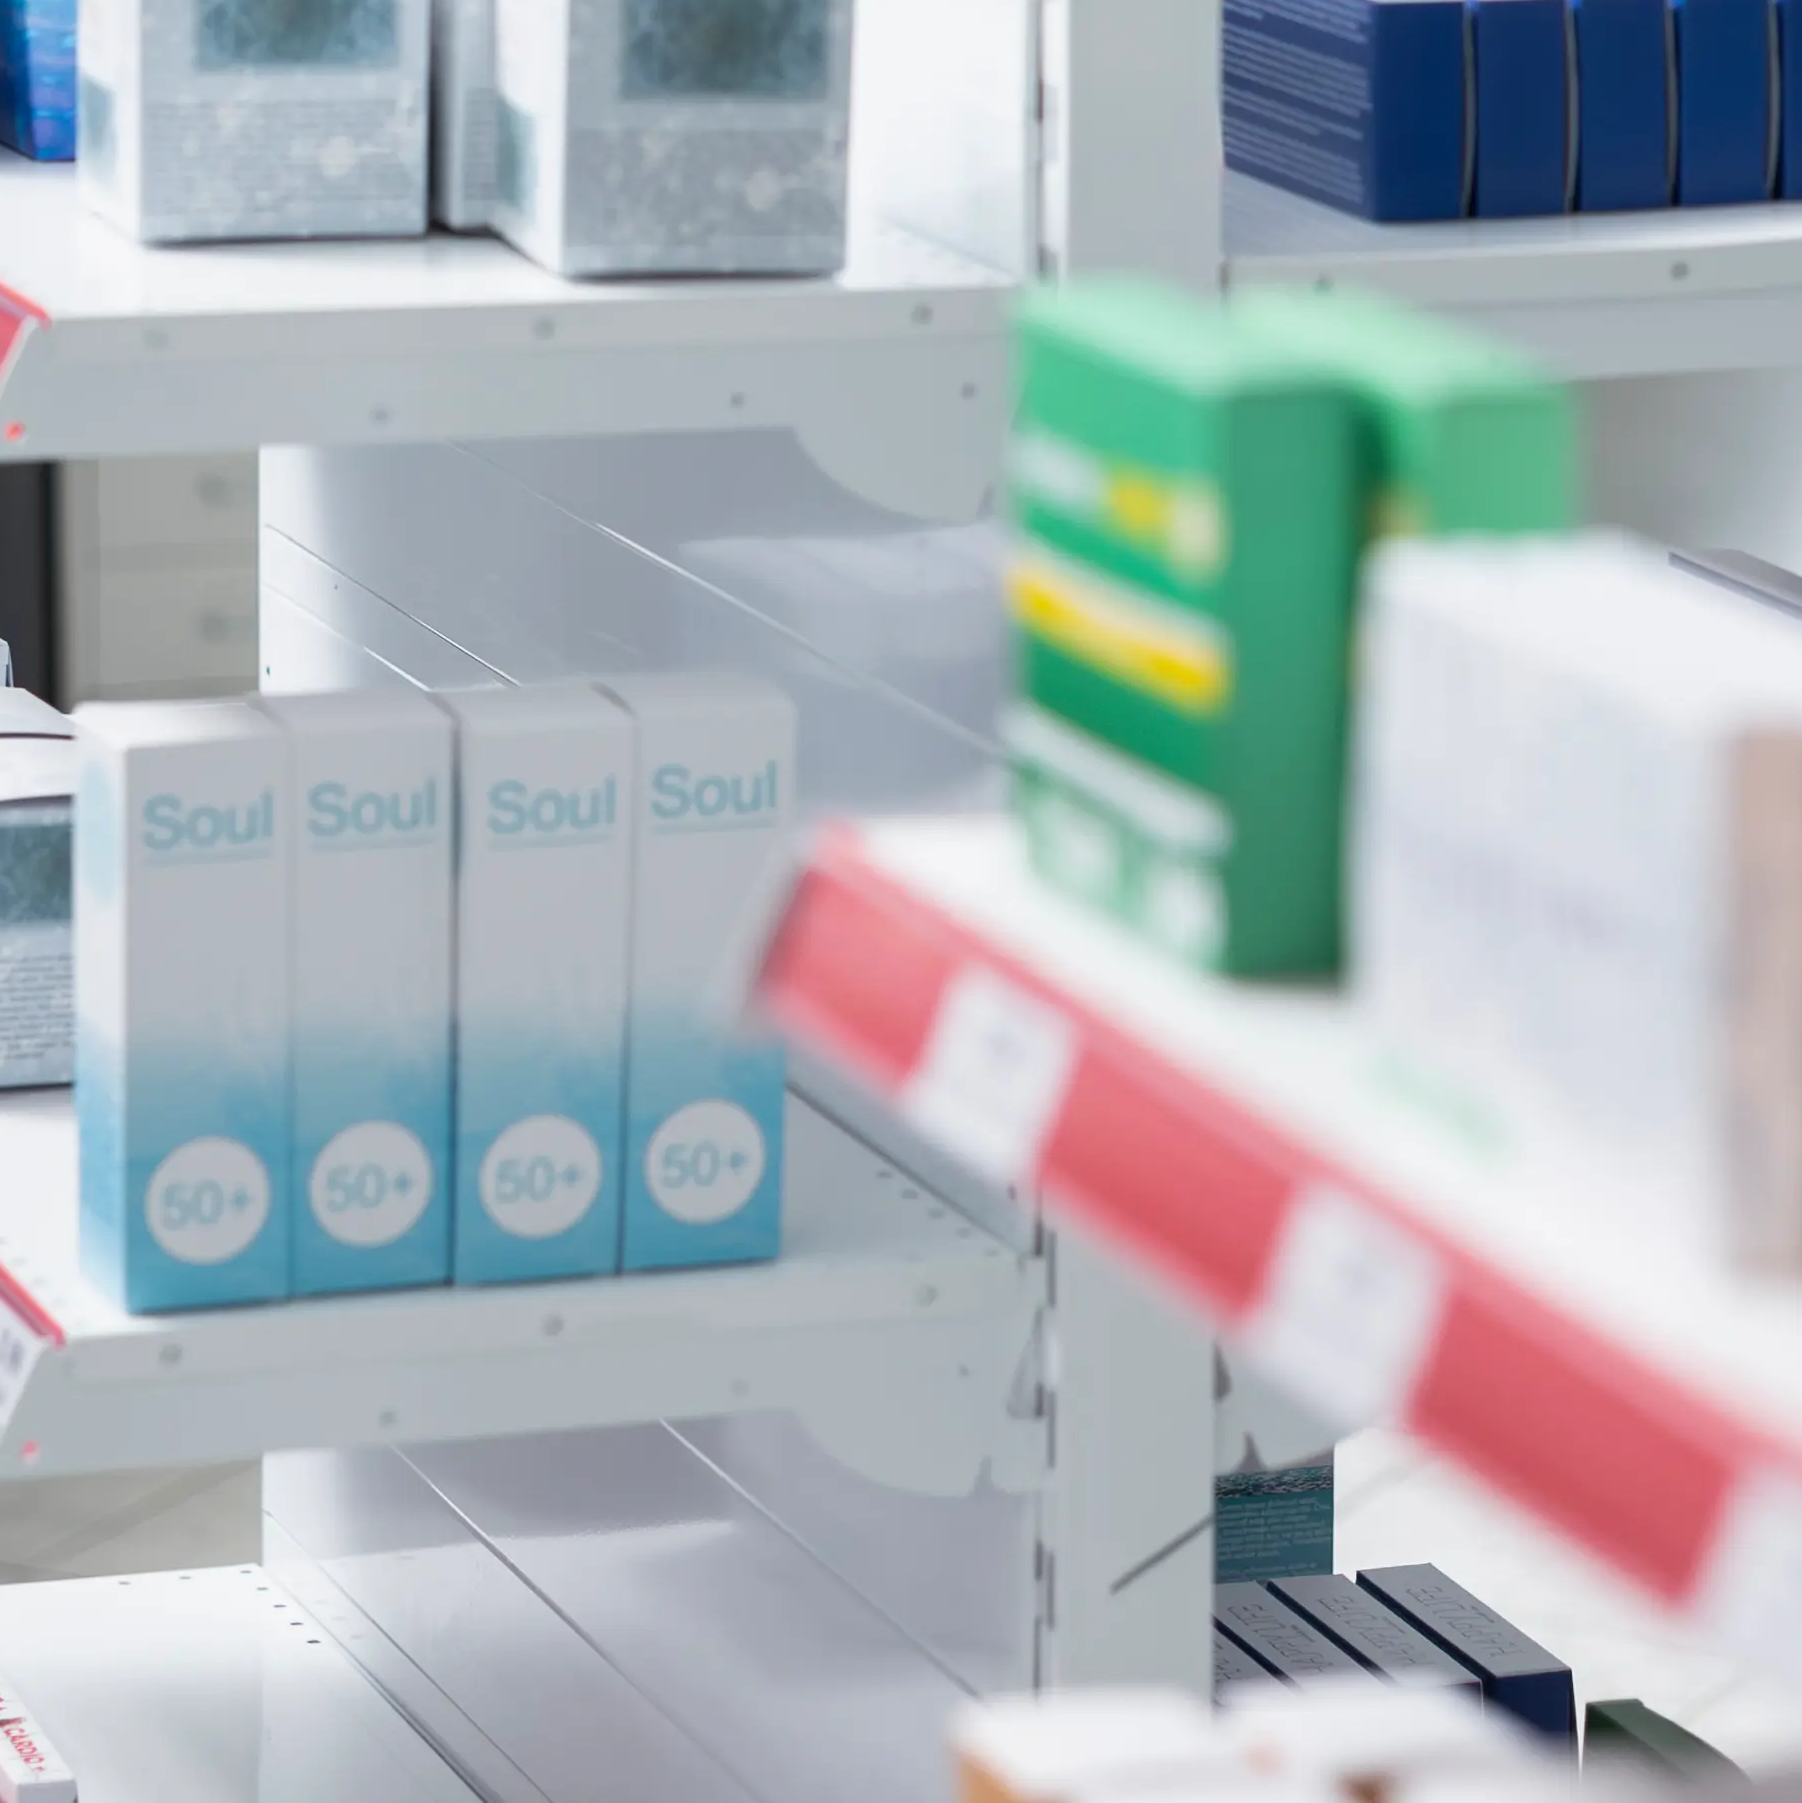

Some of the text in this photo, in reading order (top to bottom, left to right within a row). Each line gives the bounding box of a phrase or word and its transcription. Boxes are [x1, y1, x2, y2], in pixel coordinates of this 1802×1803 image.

[142, 784, 275, 853] Soul
[307, 775, 438, 839] Soul
[485, 772, 618, 836] Soul
[650, 759, 779, 821] Soul
[324, 1162, 415, 1213] 50+
[494, 1155, 587, 1205] 50+
[661, 1140, 749, 1190] 50+
[160, 1178, 252, 1231] 50+
